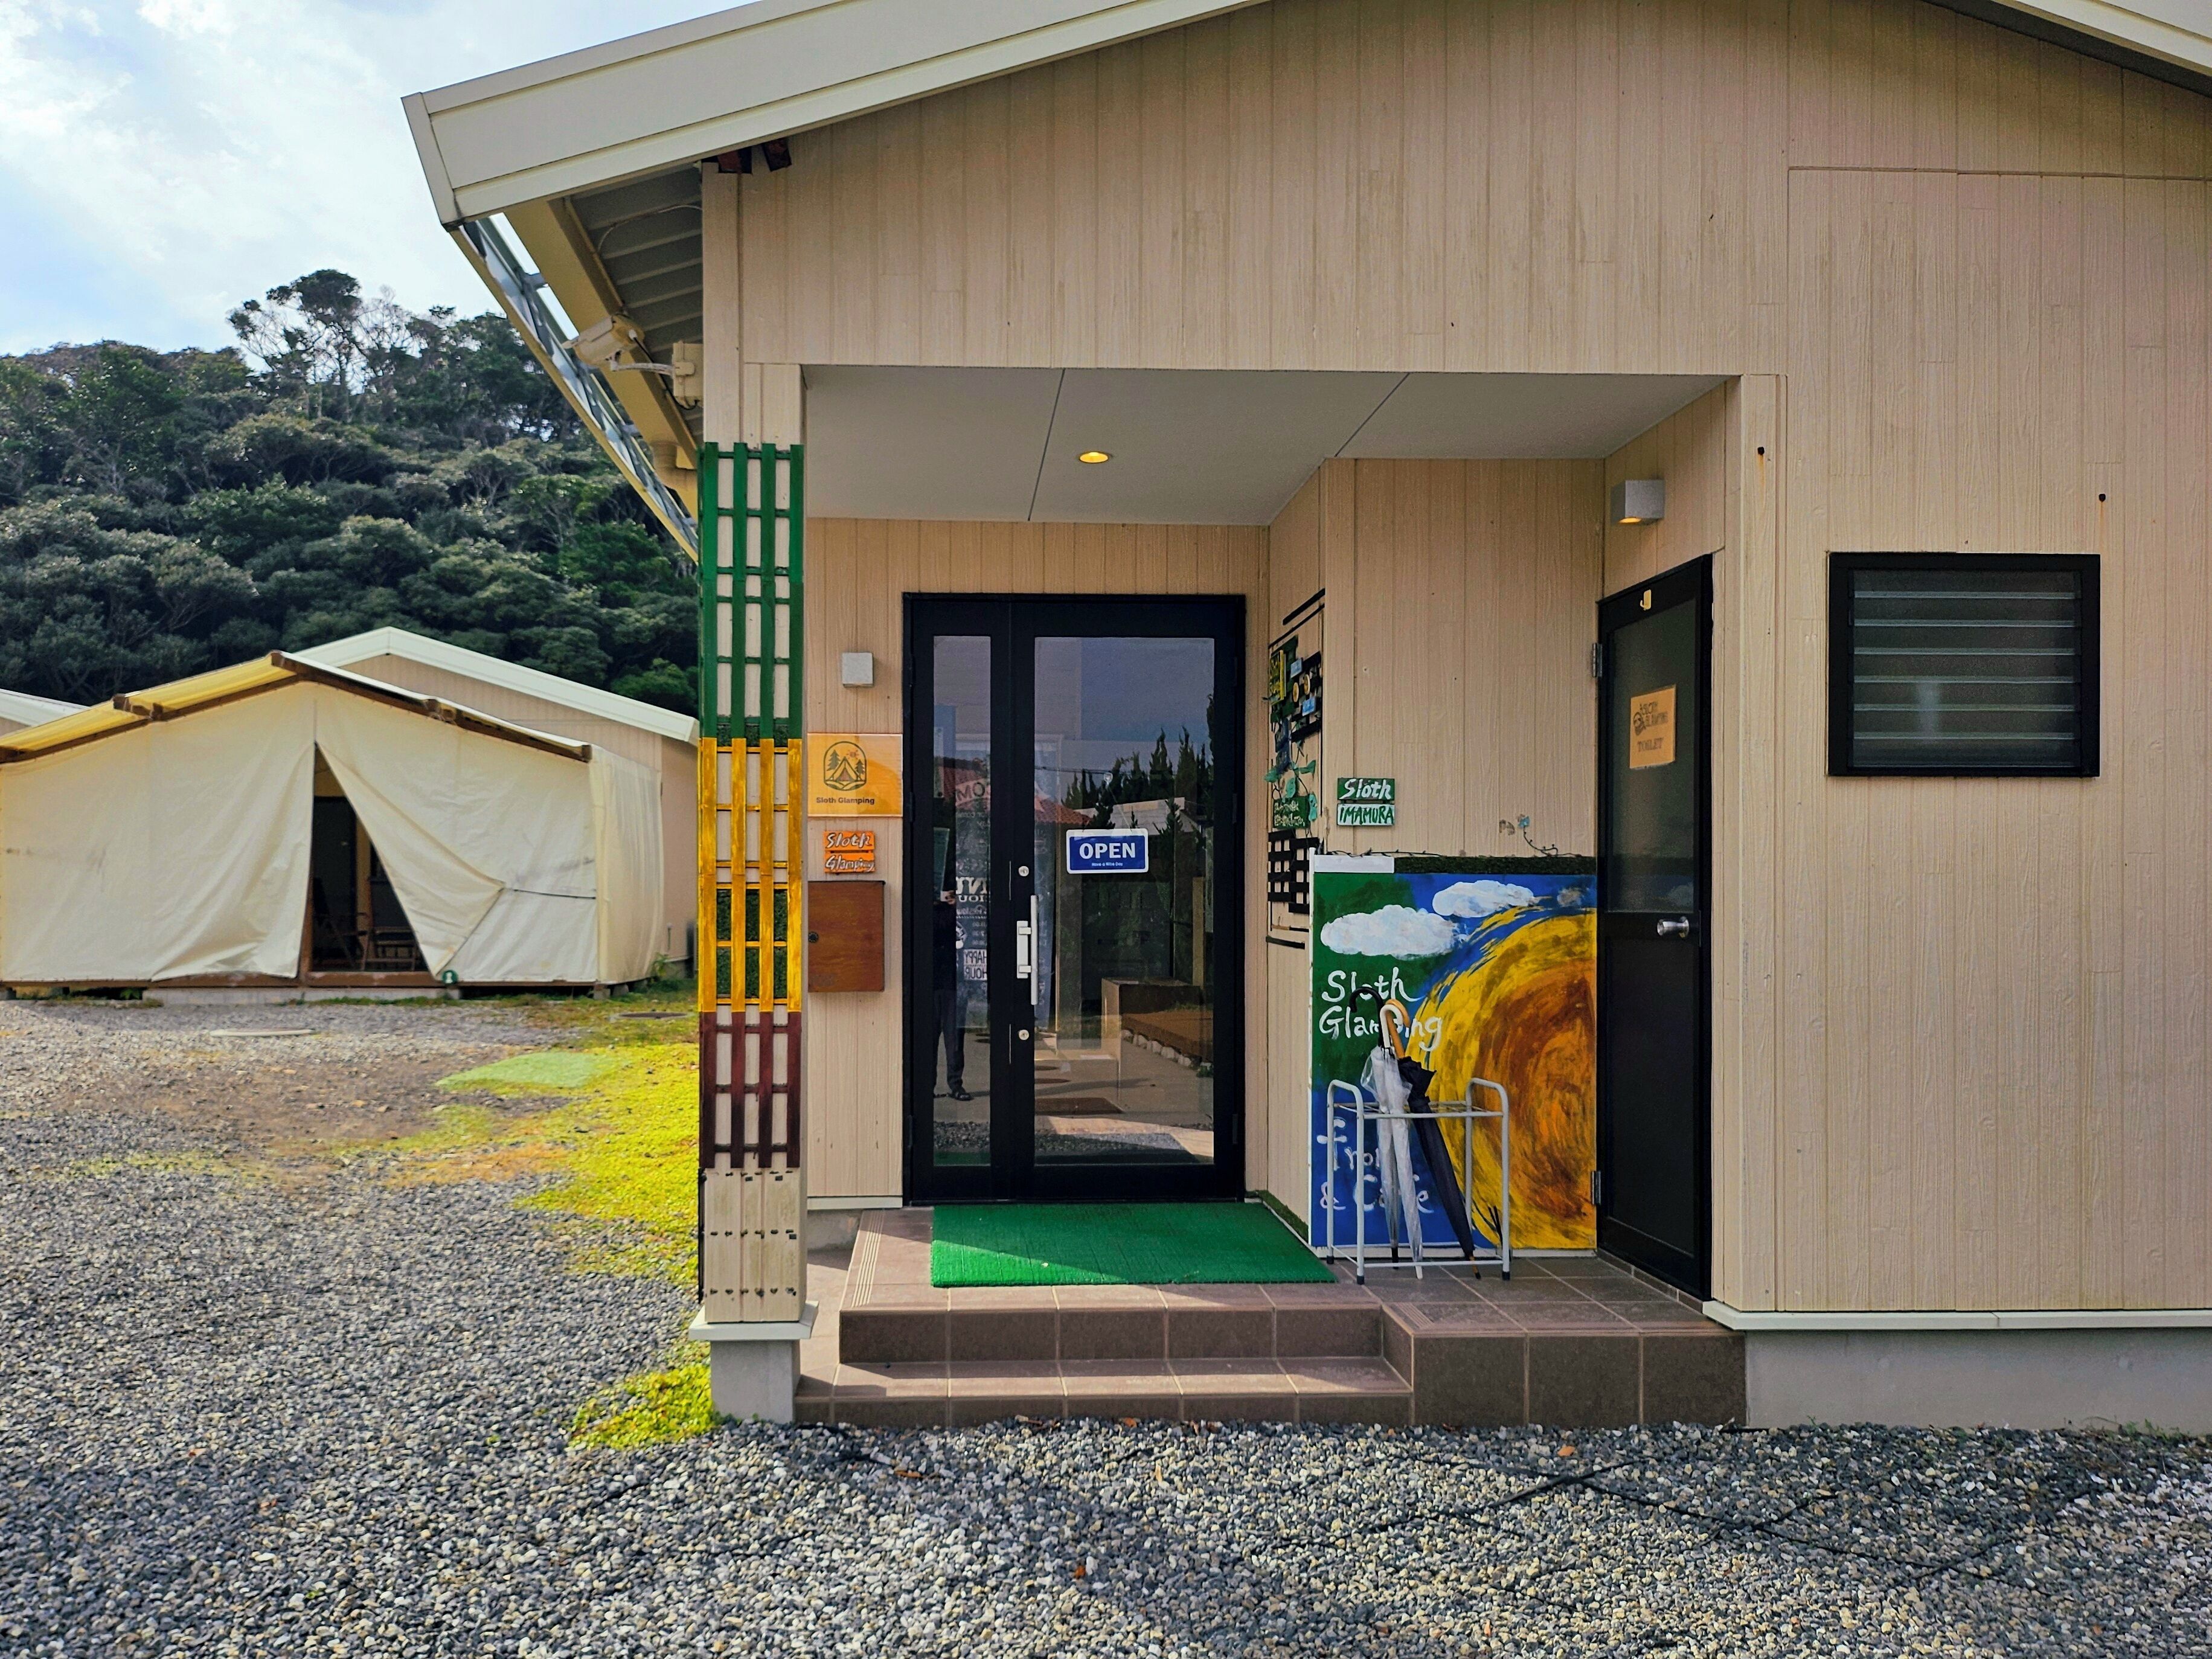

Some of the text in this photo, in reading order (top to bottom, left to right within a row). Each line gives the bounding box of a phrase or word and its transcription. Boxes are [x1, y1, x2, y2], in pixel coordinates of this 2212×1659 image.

[1339, 778, 1391, 800] Sloth
[1339, 806, 1394, 825] IMAMURA
[825, 833, 872, 848] Sloth
[1079, 842, 1136, 859] OPEN
[1321, 967, 1428, 1003] Sloth
[1353, 1173, 1434, 1213] Cae
